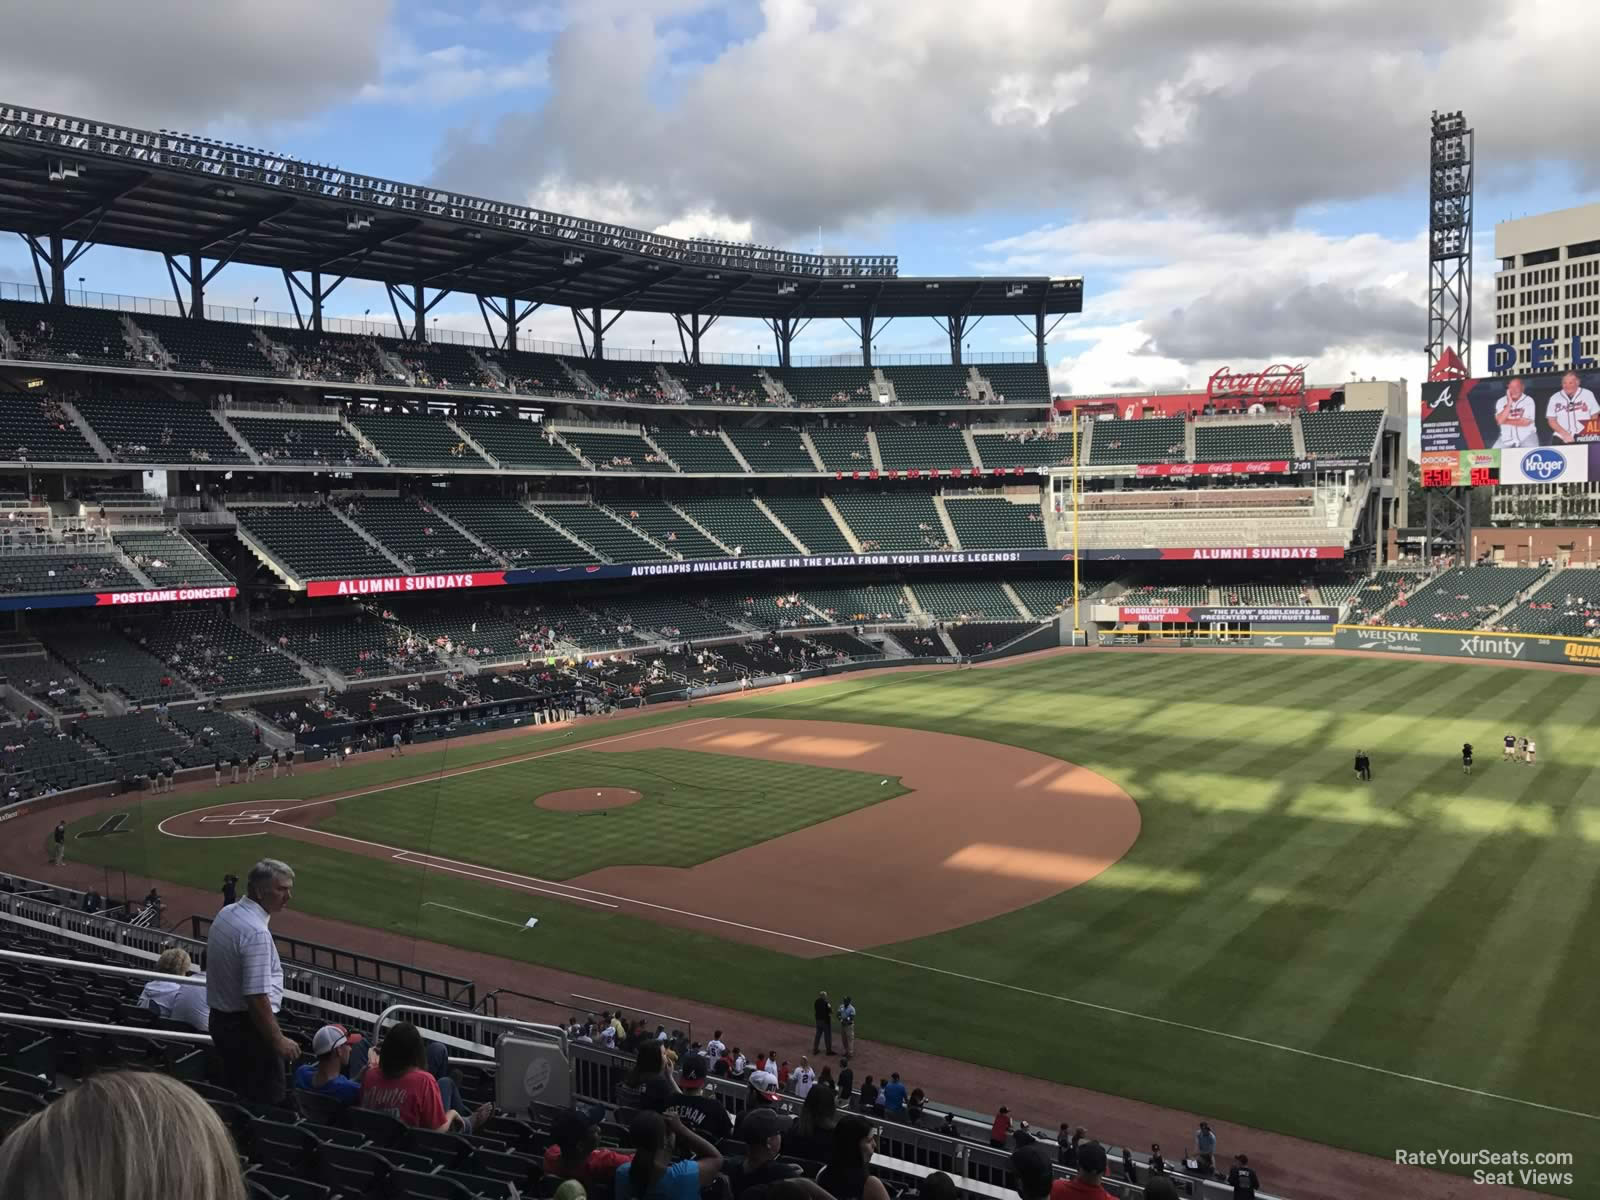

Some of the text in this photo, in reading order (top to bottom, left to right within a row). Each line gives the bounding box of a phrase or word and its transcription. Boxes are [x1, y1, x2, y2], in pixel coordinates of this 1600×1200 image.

[1207, 363, 1309, 397] Coca-Cola
[1036, 466, 1049, 475] 42
[1170, 464, 1194, 474] Coca-Cola
[1208, 463, 1232, 473] Coca-Cola
[1246, 462, 1271, 472] Coca-Cola
[1293, 462, 1311, 470] 7:01
[1525, 453, 1563, 478] Kroger
[1424, 470, 1450, 480] 250
[1471, 468, 1489, 480] 50
[1193, 548, 1317, 559] ALUMNI SUNDAYS
[631, 553, 1020, 576] AUTOGRAPHS AVAILABLE PREGAME IN THE PLAZA FROM YOUR BRAVES LEGENDS!
[338, 575, 473, 594] ALUMNI SUNDAYS
[112, 587, 231, 604] POSTGAME CONCERT
[1357, 630, 1420, 643] WELLSTAR
[1460, 635, 1525, 657] xfinity
[802, 1074, 808, 1083] 2
